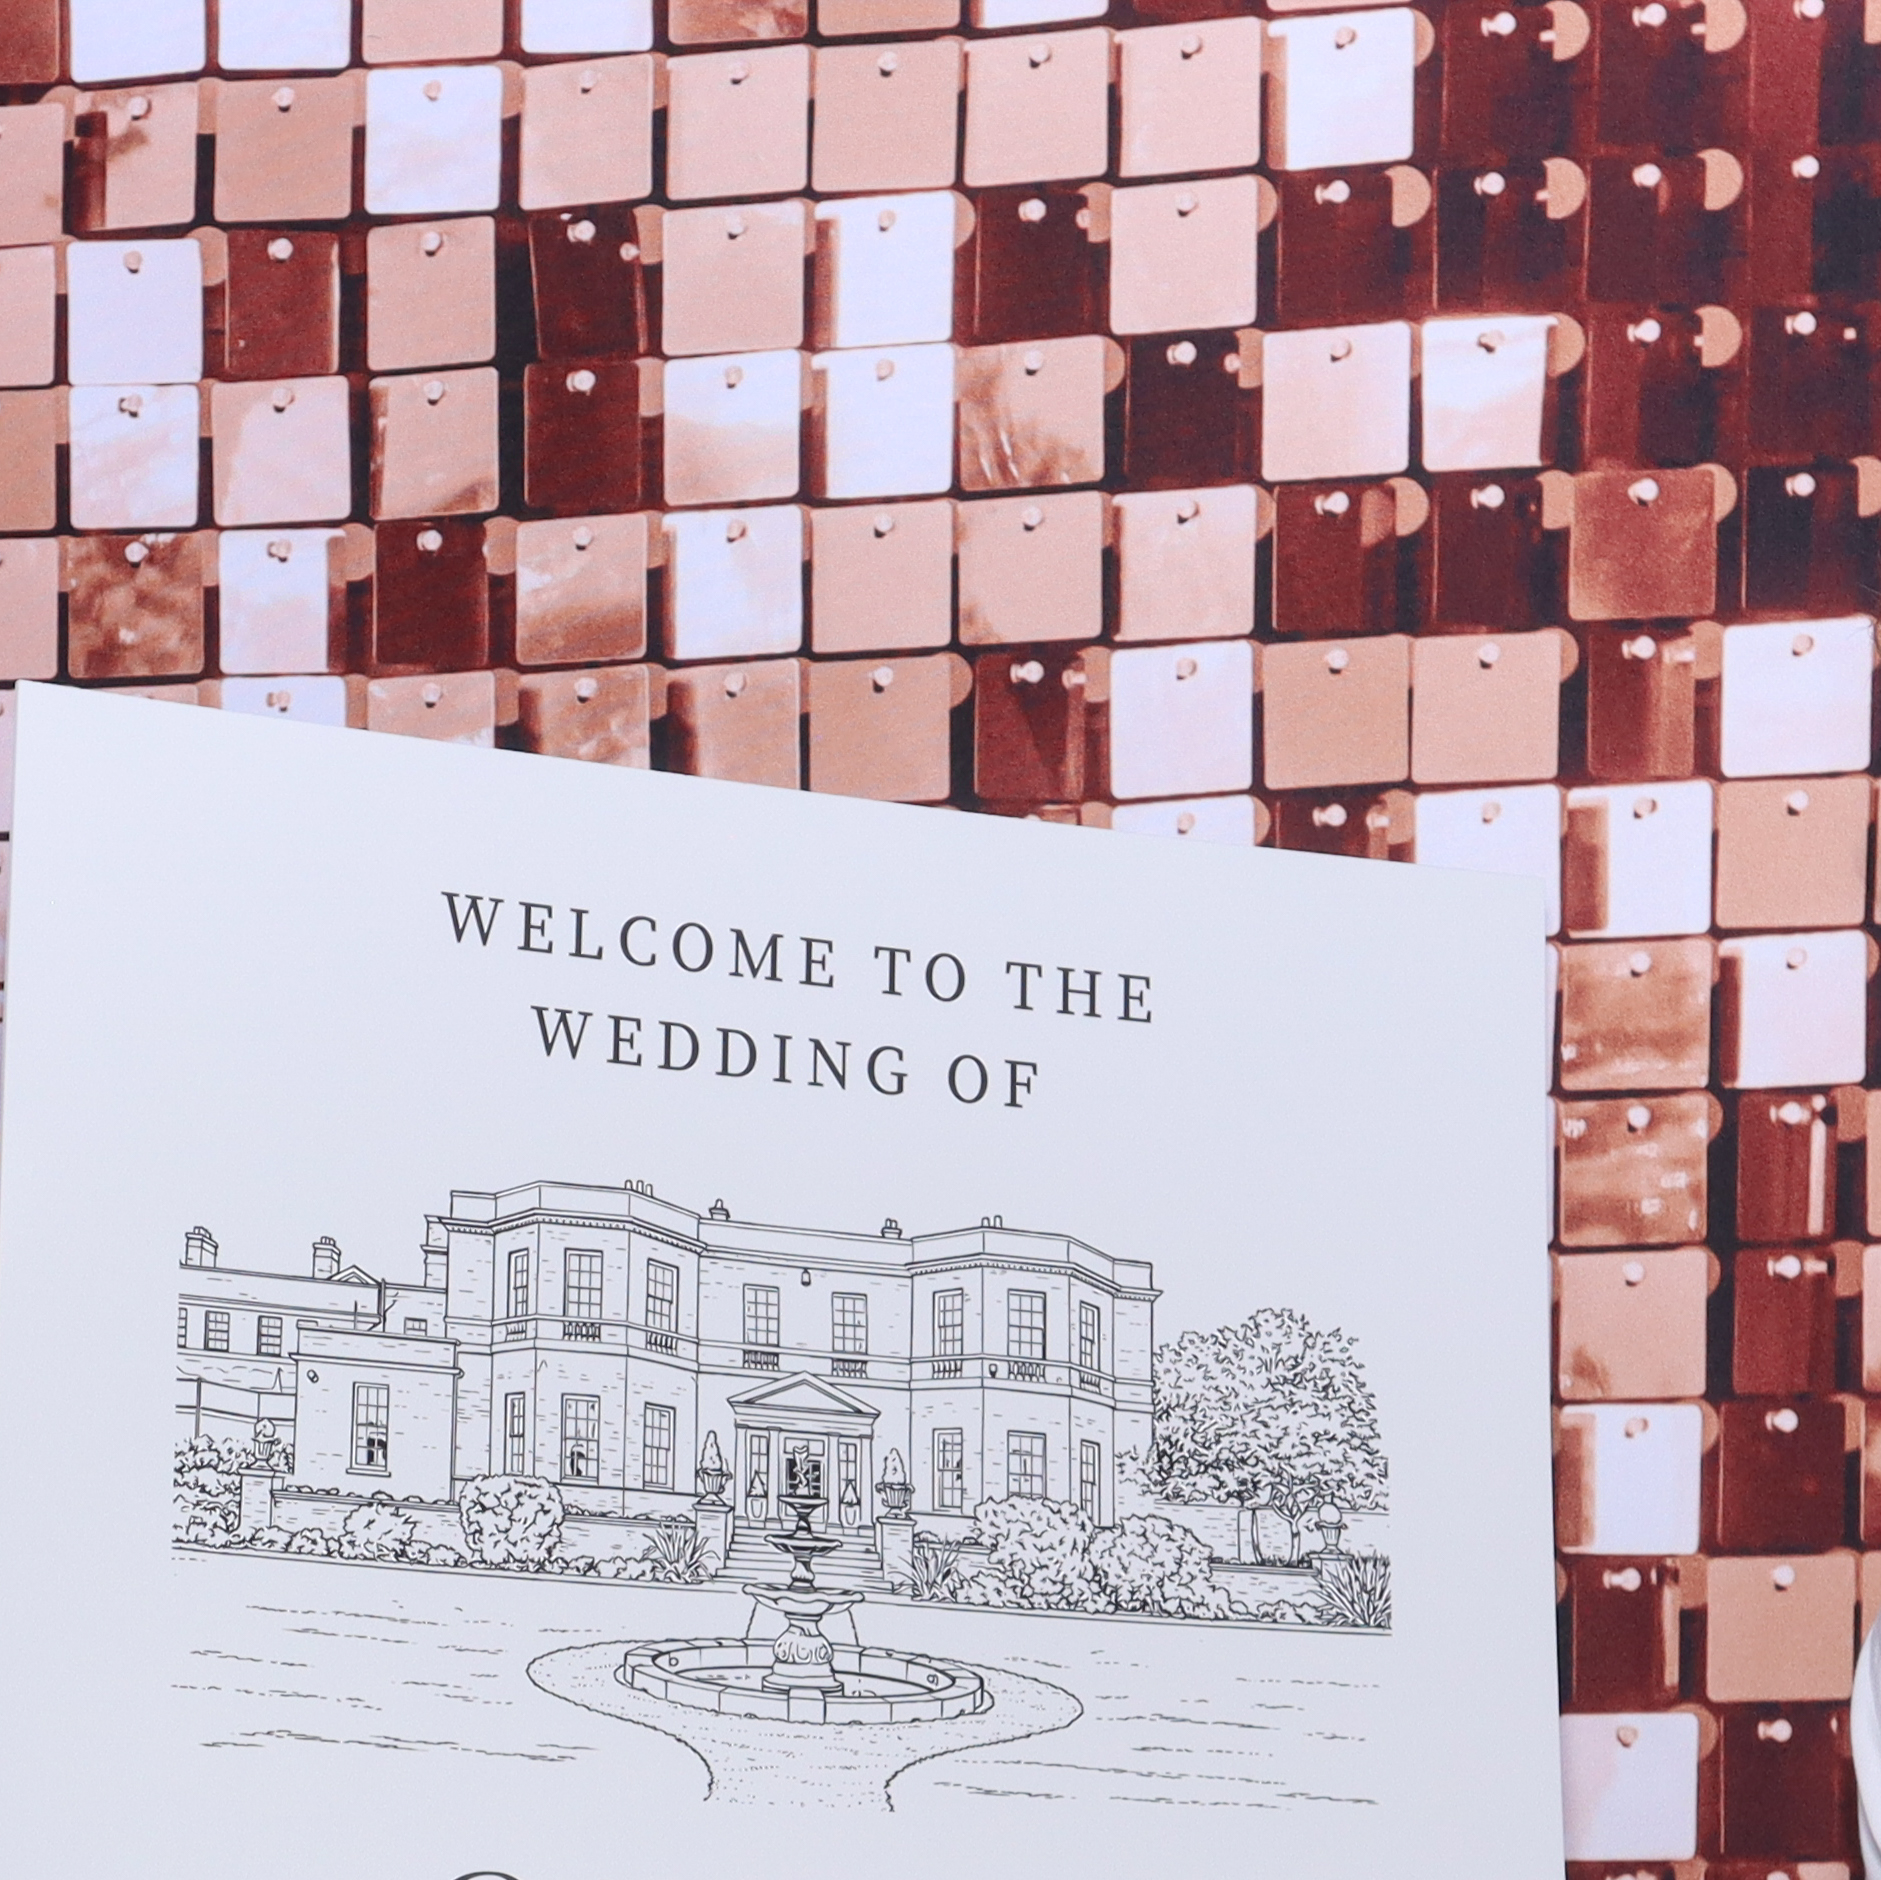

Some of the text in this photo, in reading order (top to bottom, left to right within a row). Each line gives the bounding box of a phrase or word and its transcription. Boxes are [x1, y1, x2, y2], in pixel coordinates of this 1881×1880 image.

[441, 891, 1151, 1023] WELCOME TO THE
[530, 1005, 1038, 1108] WEDDING OF
